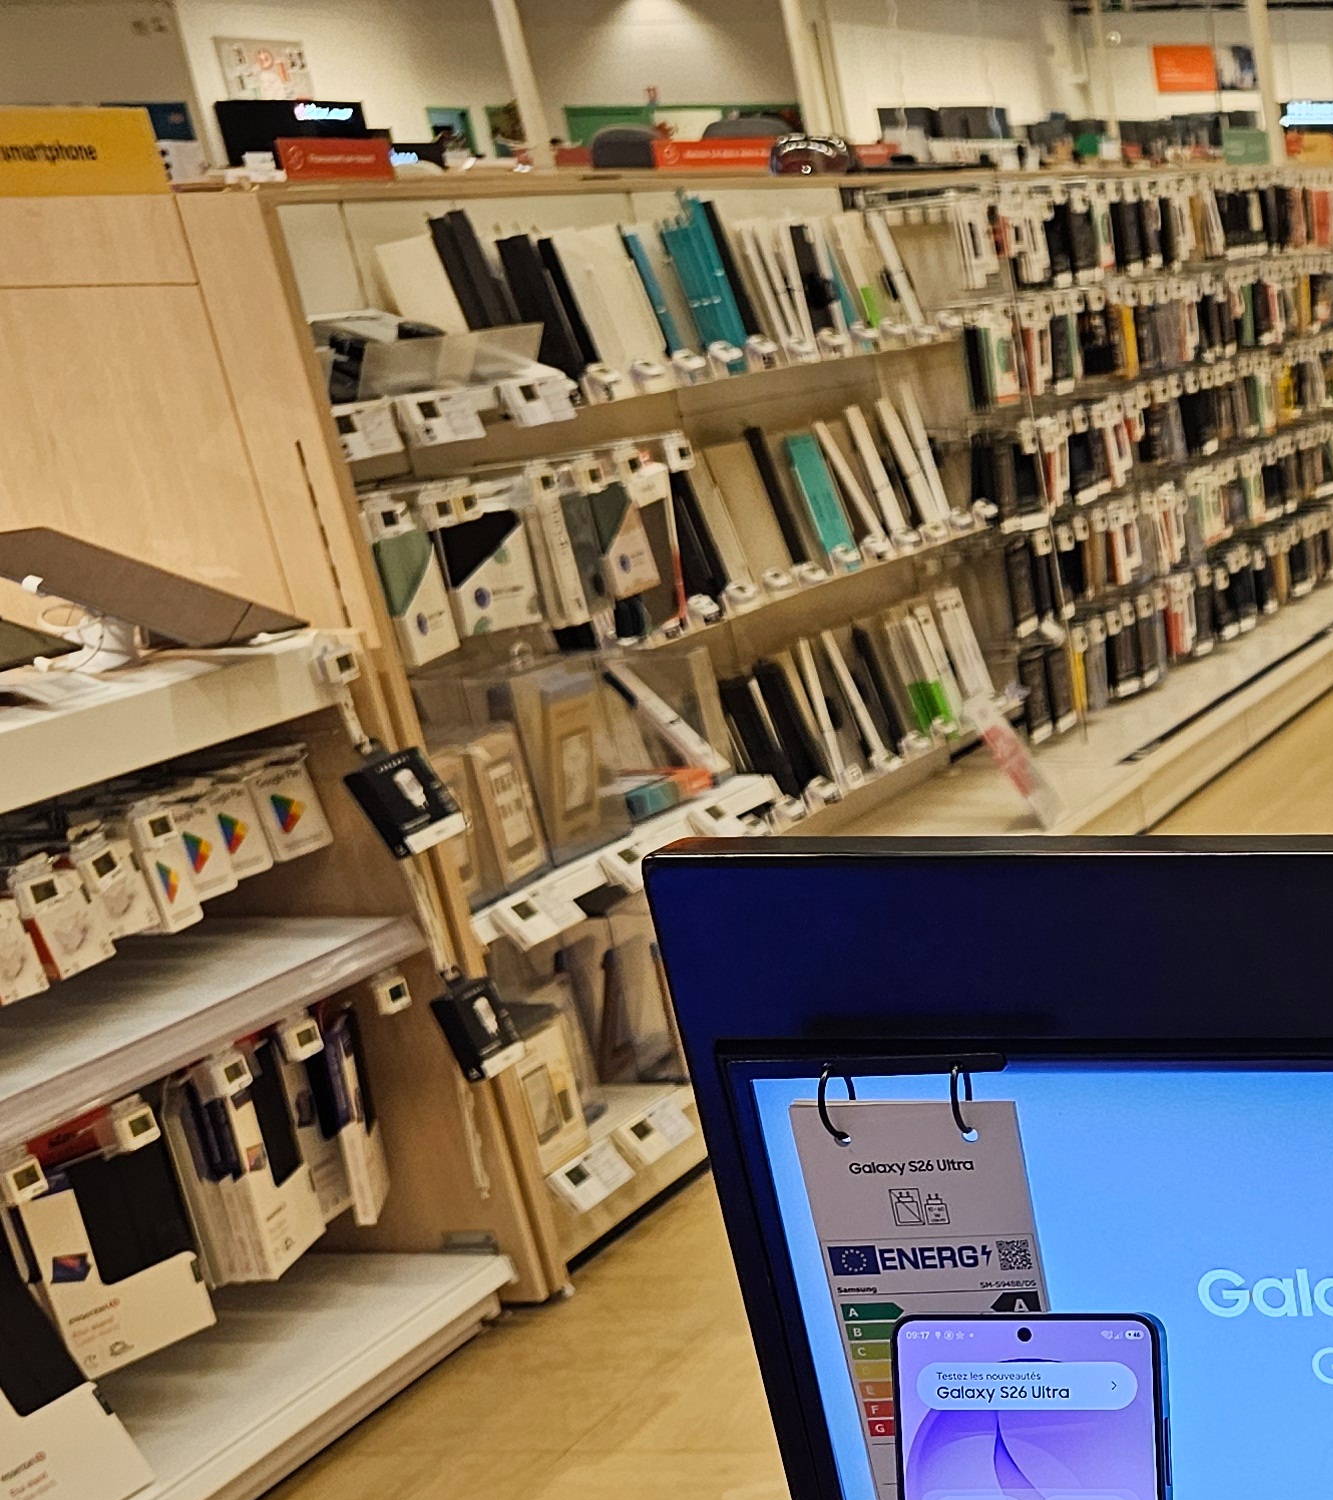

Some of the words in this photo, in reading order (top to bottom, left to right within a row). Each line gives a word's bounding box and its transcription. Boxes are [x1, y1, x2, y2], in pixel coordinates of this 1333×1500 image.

[848, 1161, 905, 1175] Galaxy
[908, 1161, 934, 1172] S26
[937, 1159, 974, 1172] Ultra
[879, 1245, 978, 1270] ENERG
[837, 1286, 877, 1295] Samsung
[1013, 1298, 1029, 1311] A
[848, 1306, 859, 1318] A
[852, 1327, 862, 1337] B
[906, 1331, 930, 1340] 09:17
[937, 1372, 968, 1380] Testez
[970, 1372, 984, 1380] les
[986, 1372, 1041, 1380] nouveautés
[936, 1386, 996, 1402] Galaxy
[1000, 1386, 1027, 1398] S26
[1032, 1386, 1070, 1398] Ultra
